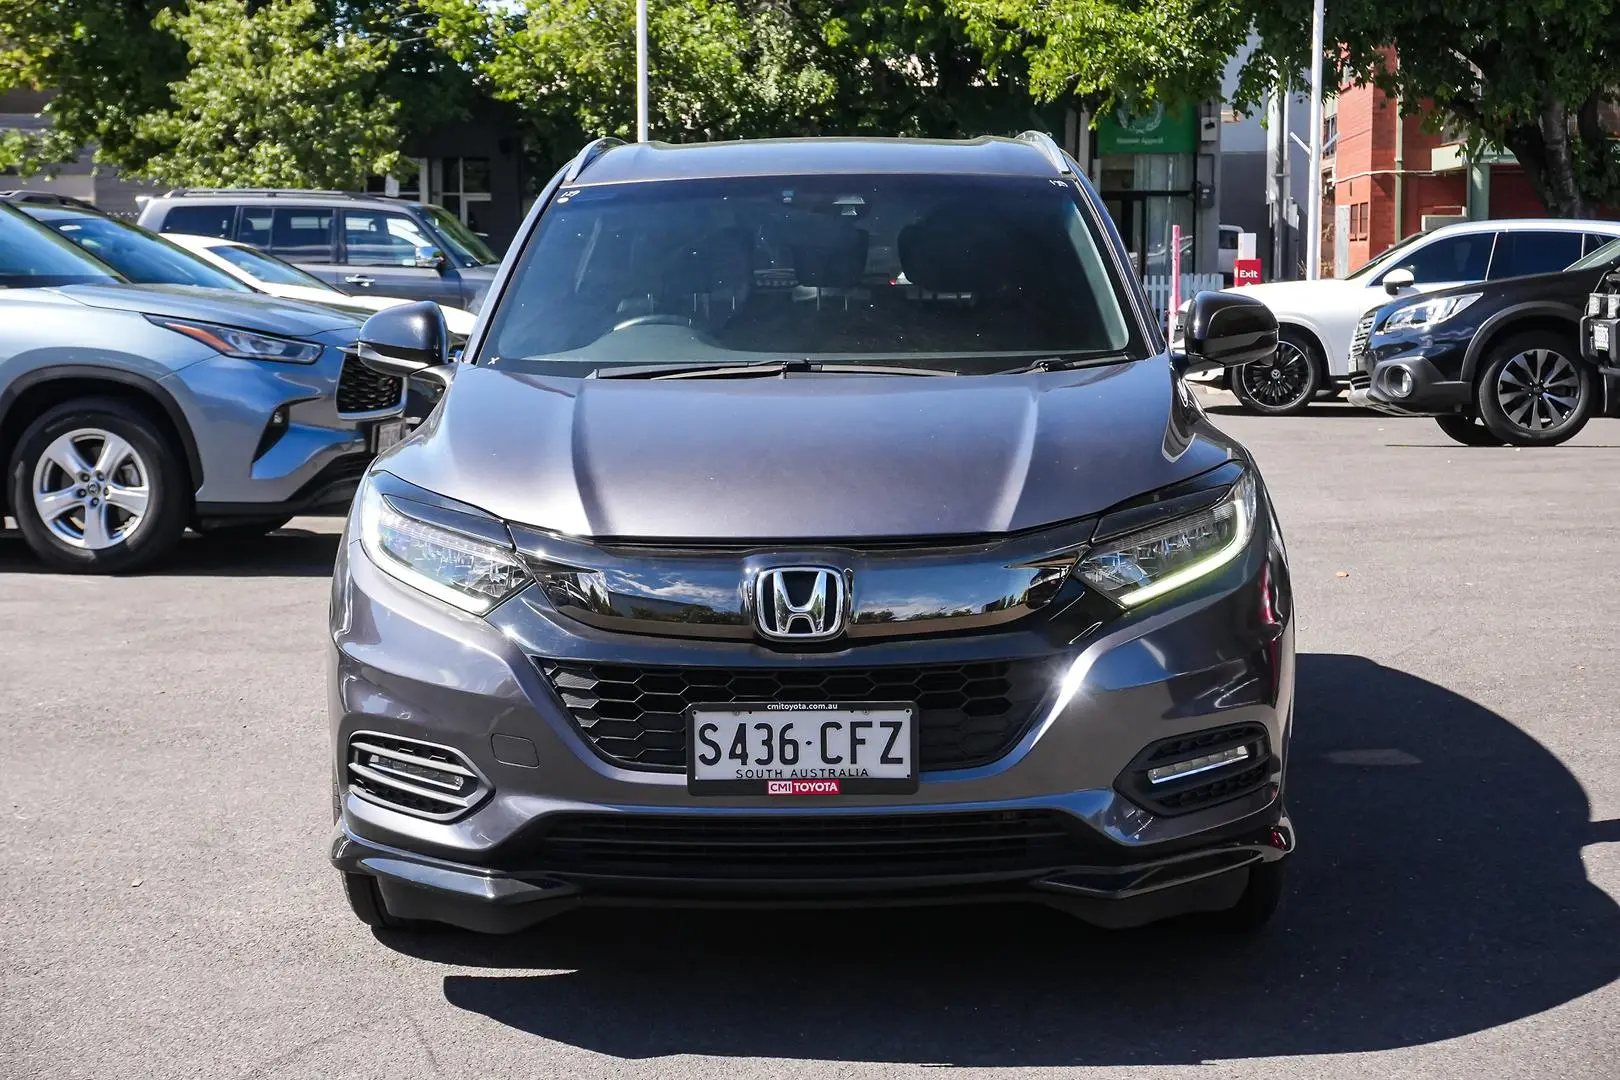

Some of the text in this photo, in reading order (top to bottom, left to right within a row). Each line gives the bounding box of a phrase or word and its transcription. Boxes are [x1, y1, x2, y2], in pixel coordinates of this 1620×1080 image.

[1239, 269, 1258, 278] Exit
[766, 702, 838, 711] cmitoyota.com.au
[735, 768, 869, 779] SOUTH AUSTRALIA
[769, 782, 838, 792] CMI TOYOTA
